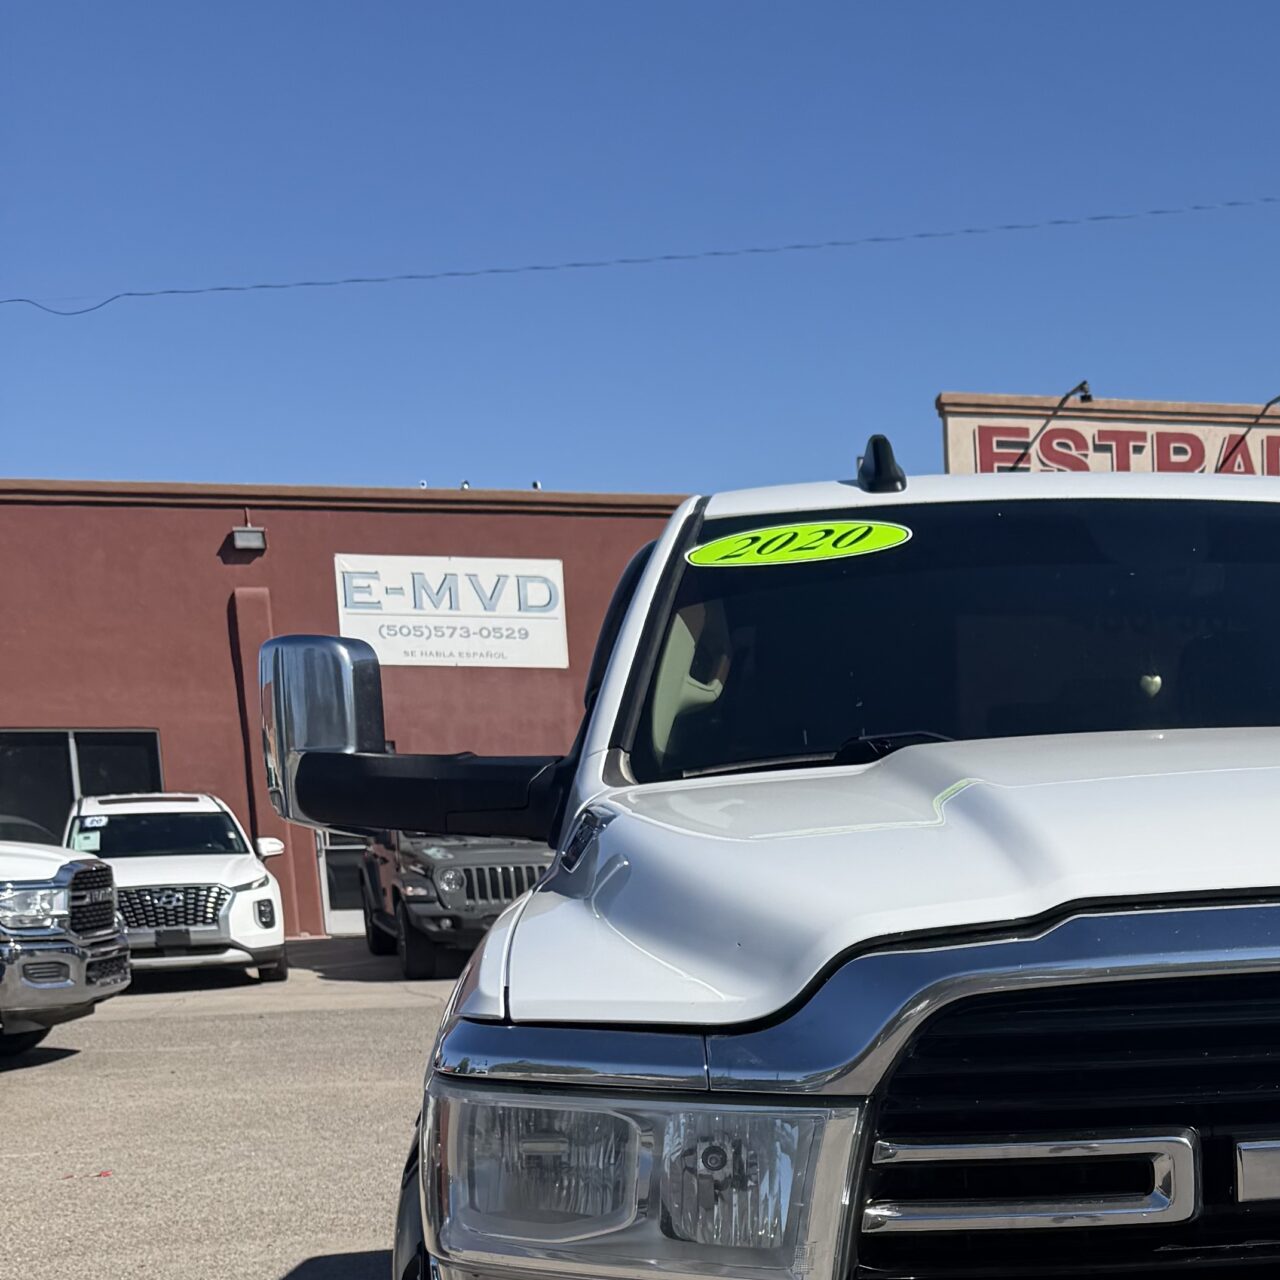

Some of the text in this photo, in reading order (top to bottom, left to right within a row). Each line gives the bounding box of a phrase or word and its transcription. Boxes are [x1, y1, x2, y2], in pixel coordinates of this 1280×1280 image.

[714, 525, 874, 562] 2020
[341, 570, 560, 613] E-MVD
[378, 623, 529, 641] (505)573-0529
[403, 650, 507, 660] SE HABLA ESPAÑOL
